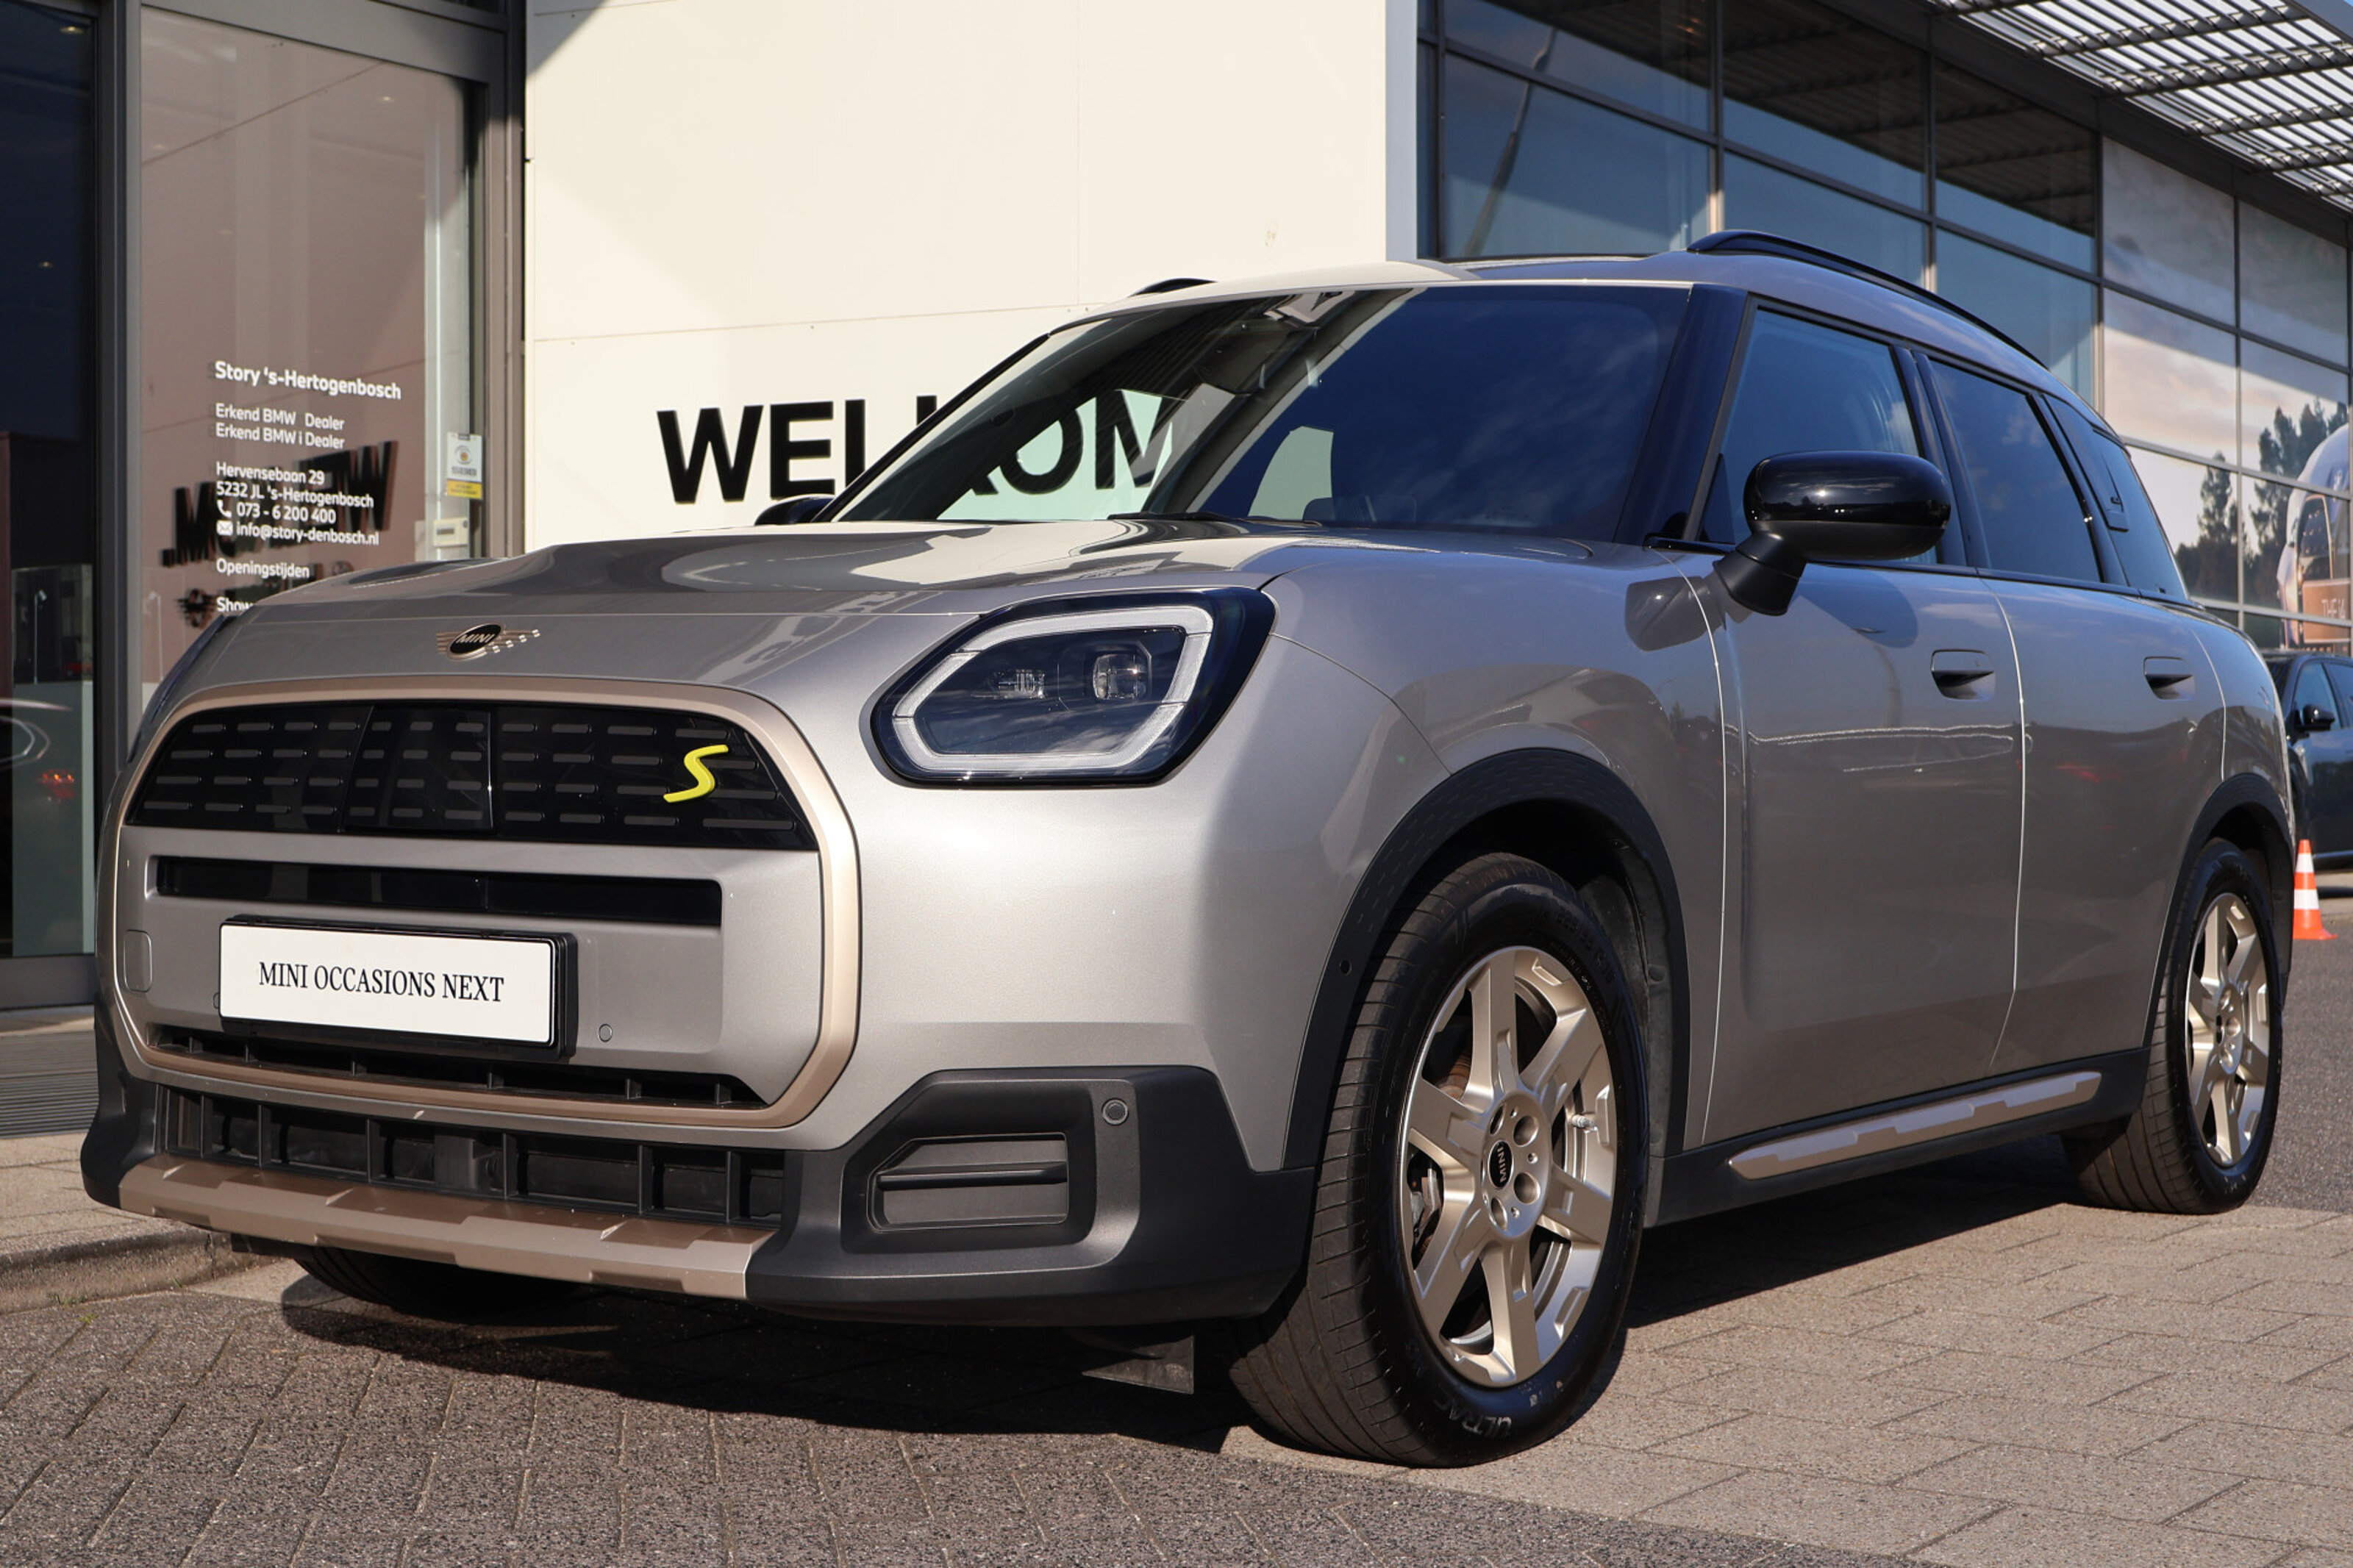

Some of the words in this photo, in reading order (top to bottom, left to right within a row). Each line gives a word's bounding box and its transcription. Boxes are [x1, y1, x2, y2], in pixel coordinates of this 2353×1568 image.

[215, 359, 260, 387] Story
[263, 366, 401, 400] 's-Hertogenbosch
[215, 403, 260, 422] Erkend
[263, 408, 296, 426] BMW
[304, 412, 345, 430] Dealer
[215, 422, 260, 441] Erkend
[263, 427, 296, 445] BMW
[298, 431, 303, 445] i
[304, 432, 345, 449] Dealer
[216, 461, 307, 484] Hervensebaan
[308, 469, 325, 485] 29
[216, 480, 249, 498] 5232
[250, 484, 265, 499] JL
[266, 485, 374, 509] 's-Hertogenbosch
[236, 501, 260, 518] 073
[271, 504, 282, 520] 6
[283, 505, 308, 522] 200
[310, 508, 336, 524] 400
[236, 520, 379, 545] info@story-denbosch.nl
[216, 557, 310, 580] Openingstijden
[456, 633, 496, 644] MINI
[663, 744, 729, 803] S
[259, 962, 309, 989] MINI
[313, 964, 436, 998] OCCASIONS
[441, 973, 504, 1002] NEXT
